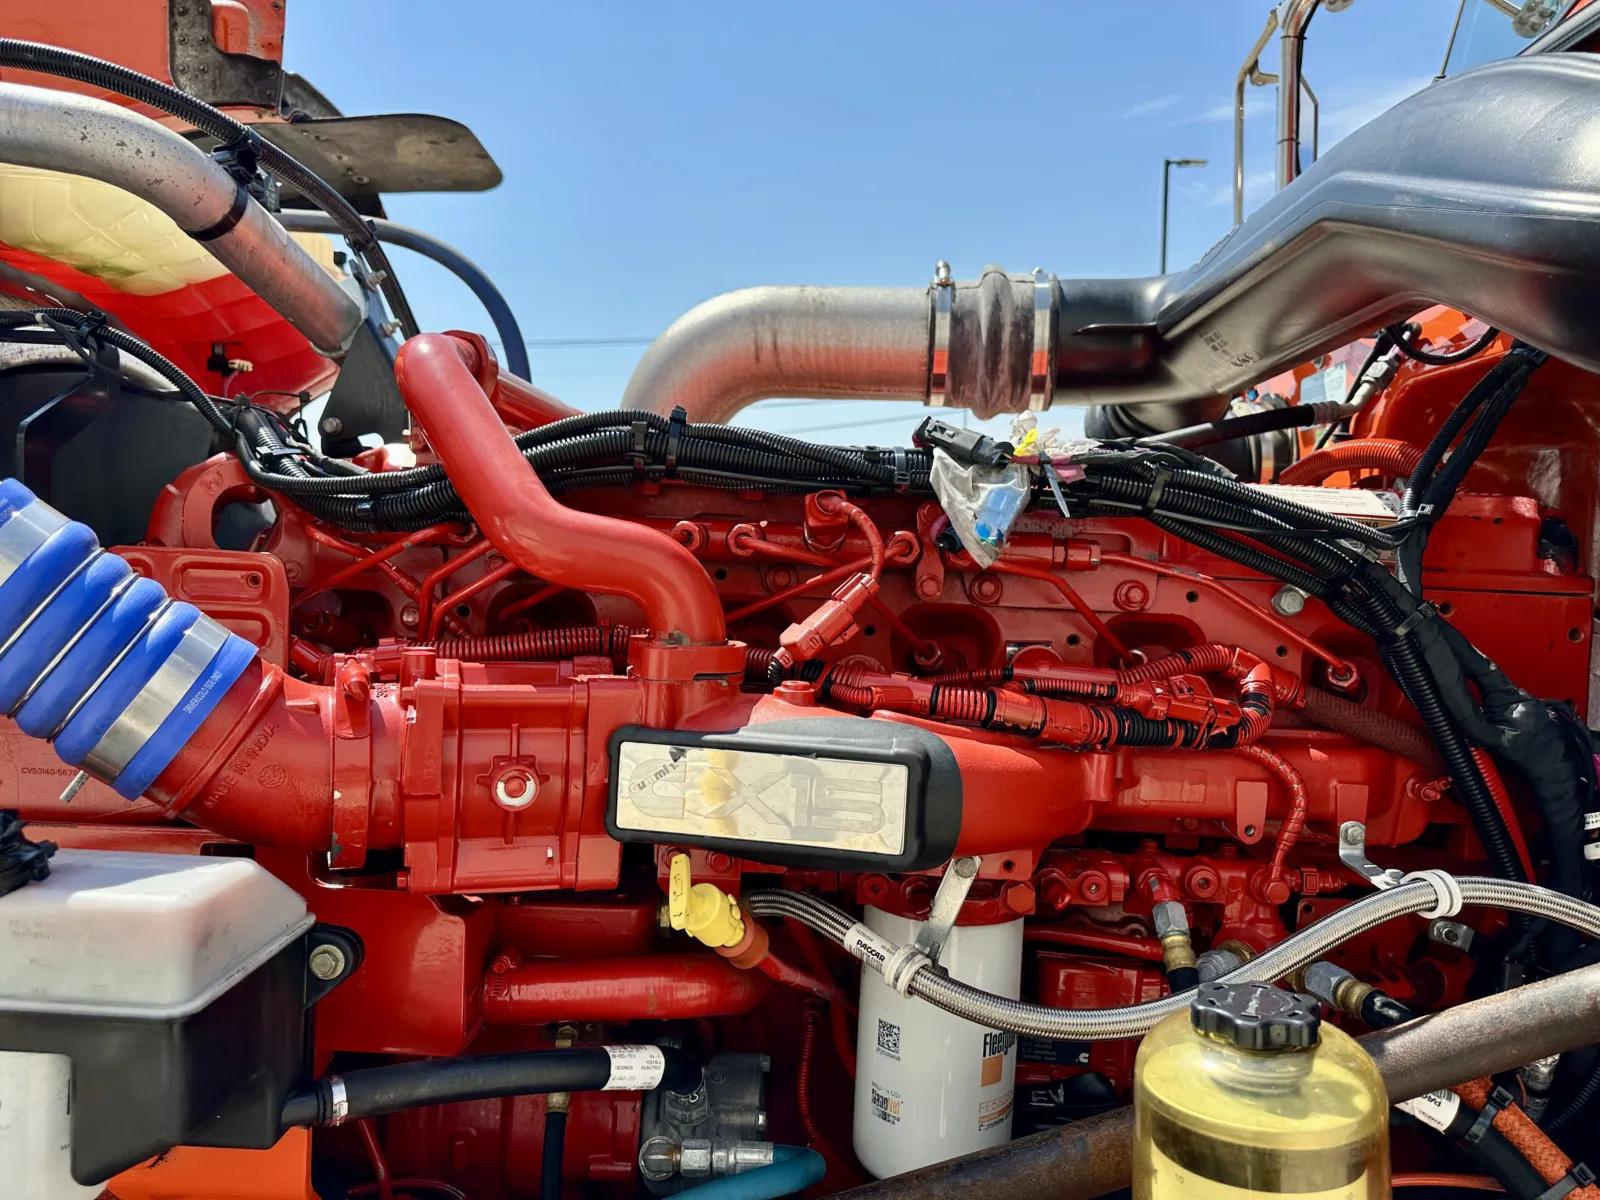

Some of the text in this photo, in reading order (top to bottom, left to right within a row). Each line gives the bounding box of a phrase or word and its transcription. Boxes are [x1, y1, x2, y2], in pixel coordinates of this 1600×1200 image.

[203, 723, 280, 808] MADE IN INDIA
[856, 939, 886, 962] PACCAR
